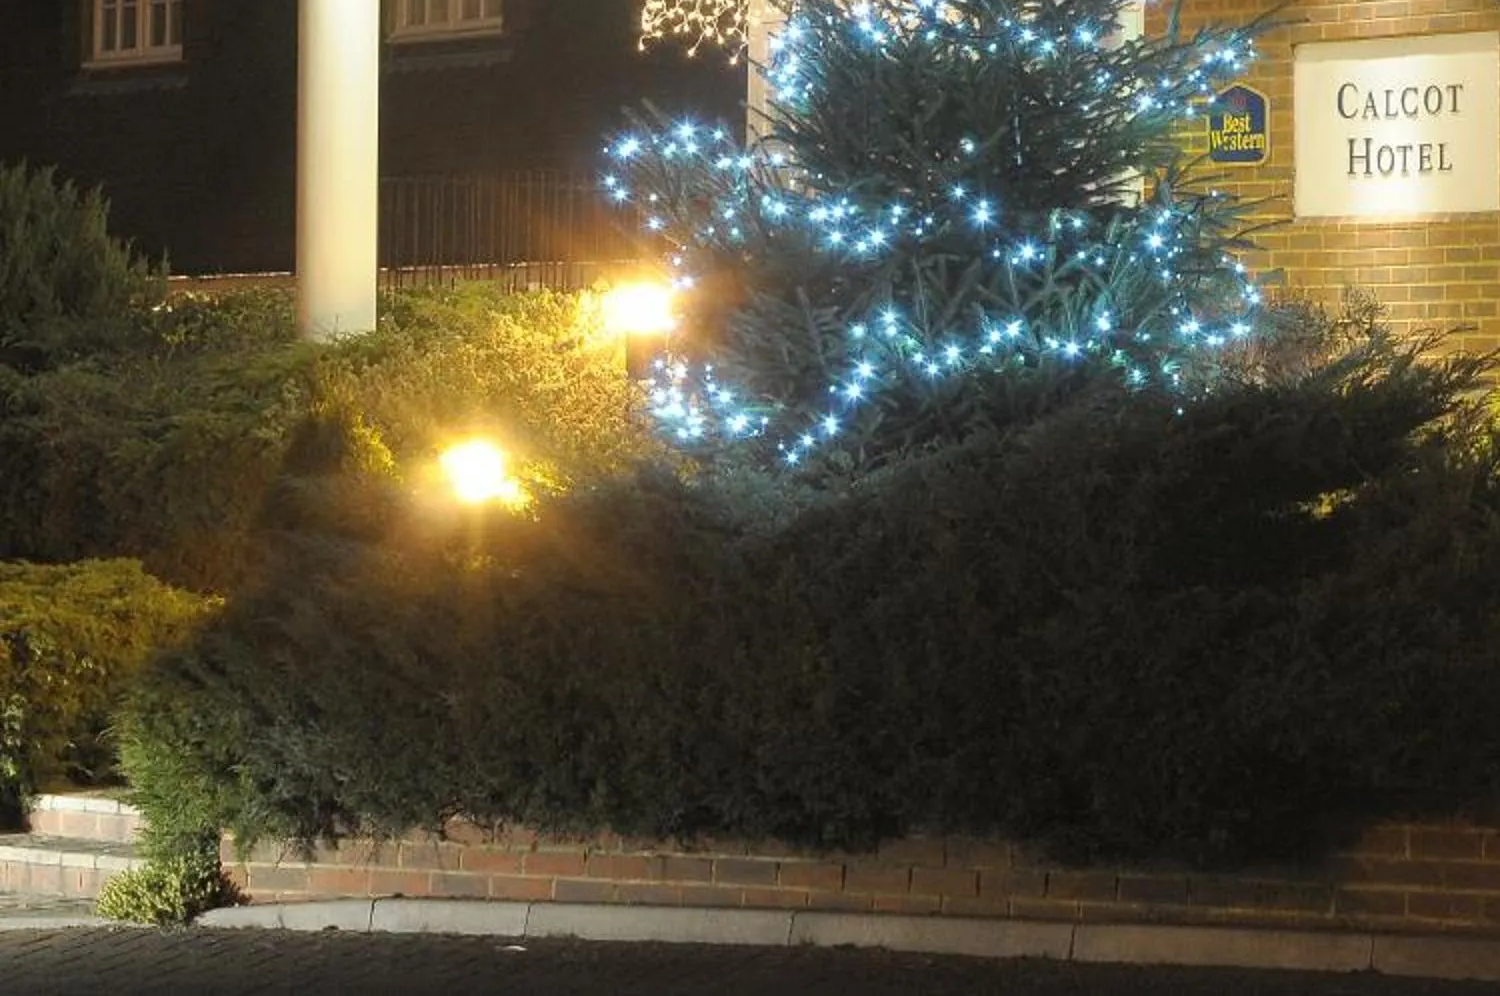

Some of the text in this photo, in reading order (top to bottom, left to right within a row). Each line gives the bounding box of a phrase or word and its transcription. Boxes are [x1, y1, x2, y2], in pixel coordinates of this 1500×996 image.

[1336, 82, 1464, 119] CALCOT
[1222, 112, 1251, 133] Best
[1346, 137, 1454, 176] HOTEL
